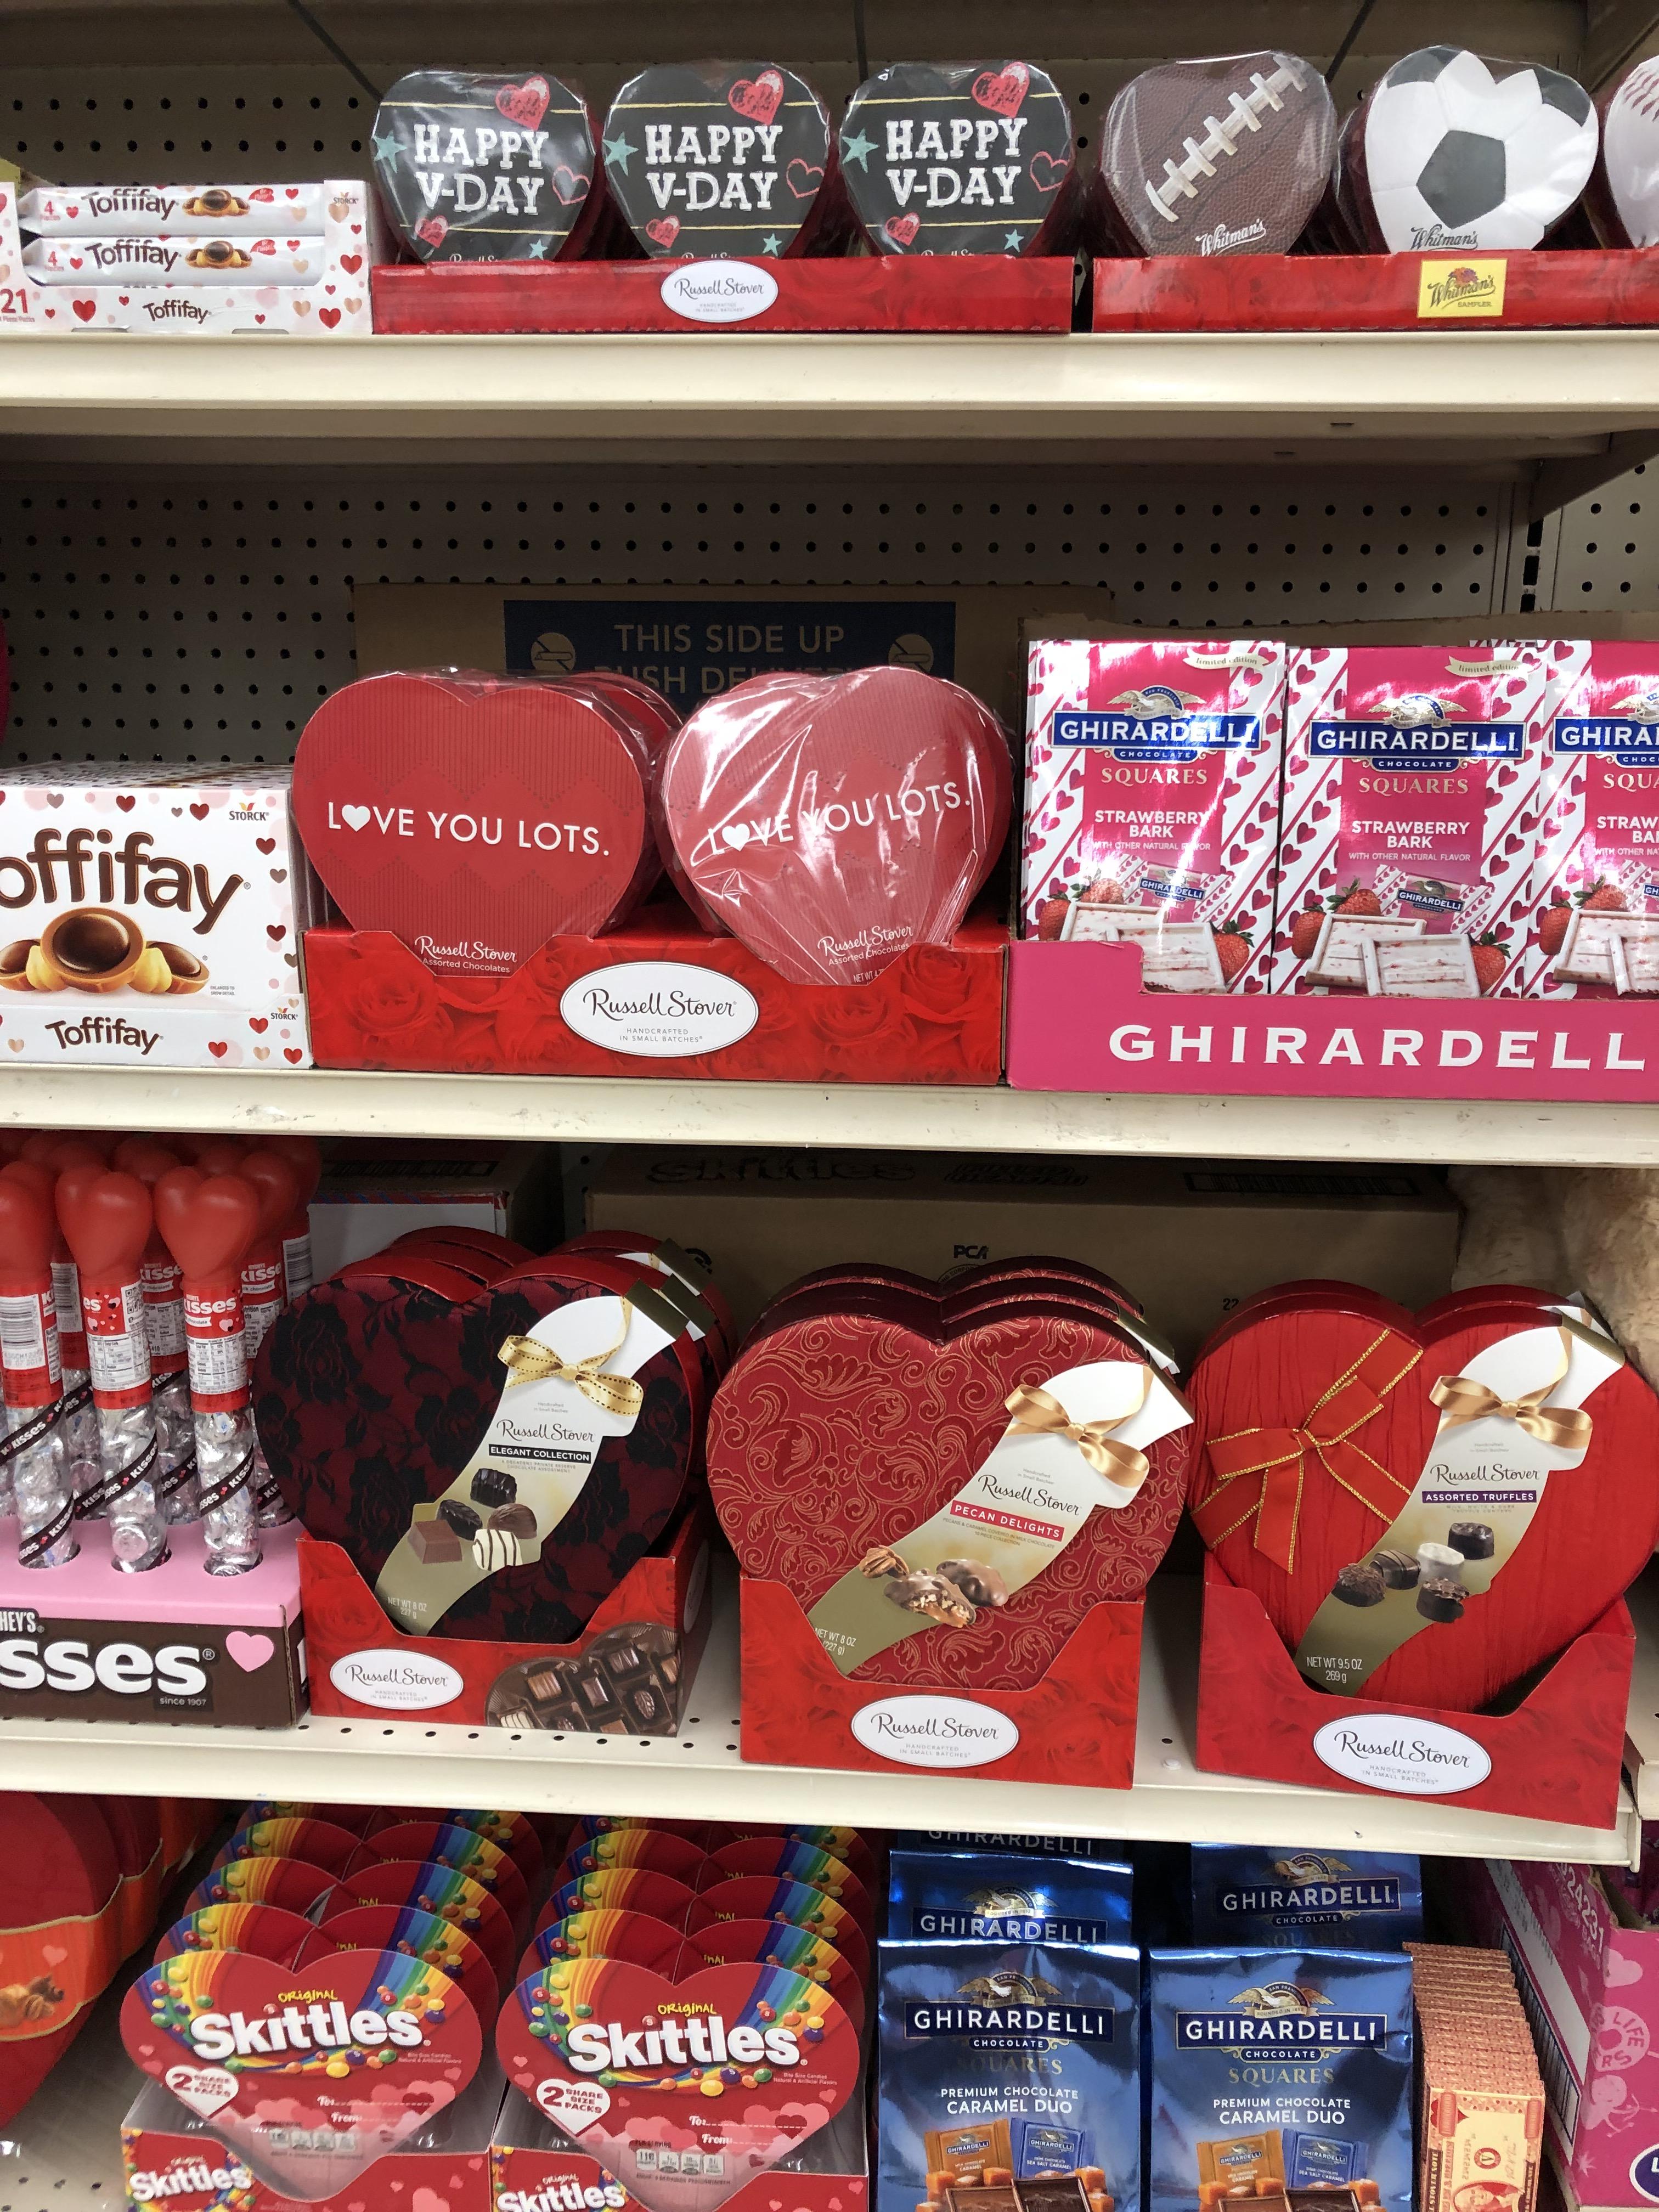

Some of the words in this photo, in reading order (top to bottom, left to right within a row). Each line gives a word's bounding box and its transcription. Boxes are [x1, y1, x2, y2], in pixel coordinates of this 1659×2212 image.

[413, 124, 549, 170] HAPPY
[645, 124, 783, 165] HAPPY
[886, 118, 1027, 161] HAPPY
[415, 171, 544, 215] V-DAY
[646, 171, 778, 211] V-DAY
[887, 166, 1022, 207] V-DAY
[44, 201, 54, 215] 4
[81, 189, 176, 221] Toffifay
[1195, 218, 1267, 256] Whitman's
[1410, 224, 1479, 250] Whitman's
[48, 251, 58, 266] 4
[84, 239, 179, 272] Toffifay
[674, 278, 724, 300] Russell
[724, 278, 764, 296] Stover
[1427, 275, 1496, 309] Whitman's
[0, 289, 29, 314] 21
[143, 300, 208, 324] Toffifay
[614, 624, 692, 653] THIS
[706, 624, 783, 653] SIDE
[799, 625, 844, 653] UP
[1060, 720, 1254, 743] GHIRARDELLI
[1317, 730, 1516, 751] GHIRARDELLI
[1561, 726, 1659, 746] GHIRA
[1101, 769, 1207, 786] SQUARES
[1359, 778, 1469, 796] SQUARES
[228, 810, 266, 821] STORCK
[802, 799, 874, 832] YOU
[886, 782, 970, 821] LOTS.
[1094, 810, 1209, 823] STRAWBERRY
[427, 811, 503, 845] YOU
[518, 820, 610, 856] LOTS.
[1129, 825, 1173, 838] BARK
[1352, 821, 1470, 834] STRAWBERRY
[1115, 842, 1141, 850] OTHER
[1143, 842, 1178, 850] NATURAL
[1387, 836, 1432, 849] BARK
[1349, 852, 1369, 860] WITH
[1372, 853, 1399, 861] OTHER
[1401, 853, 1437, 861] NATURAL
[1440, 853, 1470, 861] FLAVOR
[1399, 891, 1462, 910] GHIRARDELLI
[415, 935, 471, 960] Russell
[471, 941, 517, 963] Stover
[817, 930, 869, 957] Russell
[872, 926, 913, 945] Stover
[829, 952, 864, 966] Assorted
[867, 943, 910, 957] Chocolates
[423, 958, 460, 968] Assorted
[463, 962, 510, 973] Chocolates
[583, 988, 667, 1021] Russell
[668, 990, 735, 1017] Stover
[45, 1015, 160, 1056] Toffifay
[496, 1419, 550, 1441] Russell
[551, 1423, 595, 1442] Stover
[491, 1447, 530, 1457] ELEGANT
[534, 1450, 589, 1462] COLLECTION
[1430, 1464, 1490, 1485] Russell
[1491, 1464, 1539, 1481] Stover
[978, 1474, 1033, 1504] Russell
[1034, 1489, 1079, 1515] Stover
[955, 1504, 995, 1521] PECAN
[1001, 1516, 1060, 1537] DELIGHTS
[388, 1596, 399, 1607] NET
[401, 1600, 411, 1609] WT
[419, 1602, 427, 1612] OZ
[400, 1607, 411, 1616] 227
[815, 1627, 827, 1639] NET
[828, 1631, 840, 1641] WT
[840, 1633, 845, 1644] 8
[846, 1635, 856, 1647] OZ
[1306, 1657, 1322, 1668] NET
[1323, 1657, 1336, 1668] WT
[1338, 1658, 1350, 1669] 9.5
[1351, 1659, 1363, 1671] OZ
[345, 1664, 402, 1686] Russell
[402, 1668, 447, 1686] Stover
[1326, 1670, 1340, 1681] 269
[1342, 1673, 1347, 1684] g
[160, 1697, 185, 1706] since
[188, 1699, 206, 1707] 1907
[871, 1713, 942, 1739] Russell
[941, 1718, 998, 1740] Stover
[906, 1743, 960, 1752] HANDCRAFTED
[1334, 1731, 1408, 1759] Russell
[1409, 1741, 1470, 1768] Stover
[1370, 1765, 1426, 1777] HANDCRAFTED
[1374, 1771, 1399, 1780] SMALL
[1223, 1886, 1392, 1911] GHIRARDELLI
[920, 1915, 1097, 1943] GHIRARDELLI
[1276, 1915, 1338, 1925] CHOCOLATE
[190, 2002, 423, 2061] Skittles
[914, 2010, 1103, 2035] GHIRARDELLI
[1186, 2021, 1375, 2041] GHIRARDELLI
[567, 2016, 800, 2073] Skittles
[974, 2039, 1043, 2048] CHOCOLATE
[1246, 2050, 1316, 2058] CHOCOLATE
[173, 2074, 191, 2092] 2
[1229, 2068, 1335, 2087] SQUARES
[543, 2087, 563, 2107] 2
[566, 2089, 604, 2100] SHARE
[941, 2087, 998, 2098] PREMIUM
[1004, 2087, 1079, 2100] CHOCOLATE
[1214, 2098, 1270, 2109] PREMIUM
[1276, 2098, 1351, 2109] CHOCOLATE
[565, 2103, 602, 2114] PACKS
[946, 2100, 1028, 2114] CARAMEL
[1034, 2100, 1072, 2114] DUO
[689, 2115, 706, 2126] To:
[1219, 2111, 1300, 2125] CARAMEL
[1306, 2112, 1345, 2125] DUO
[129, 2163, 251, 2202] Skittles
[497, 2183, 625, 2212] Skittles
